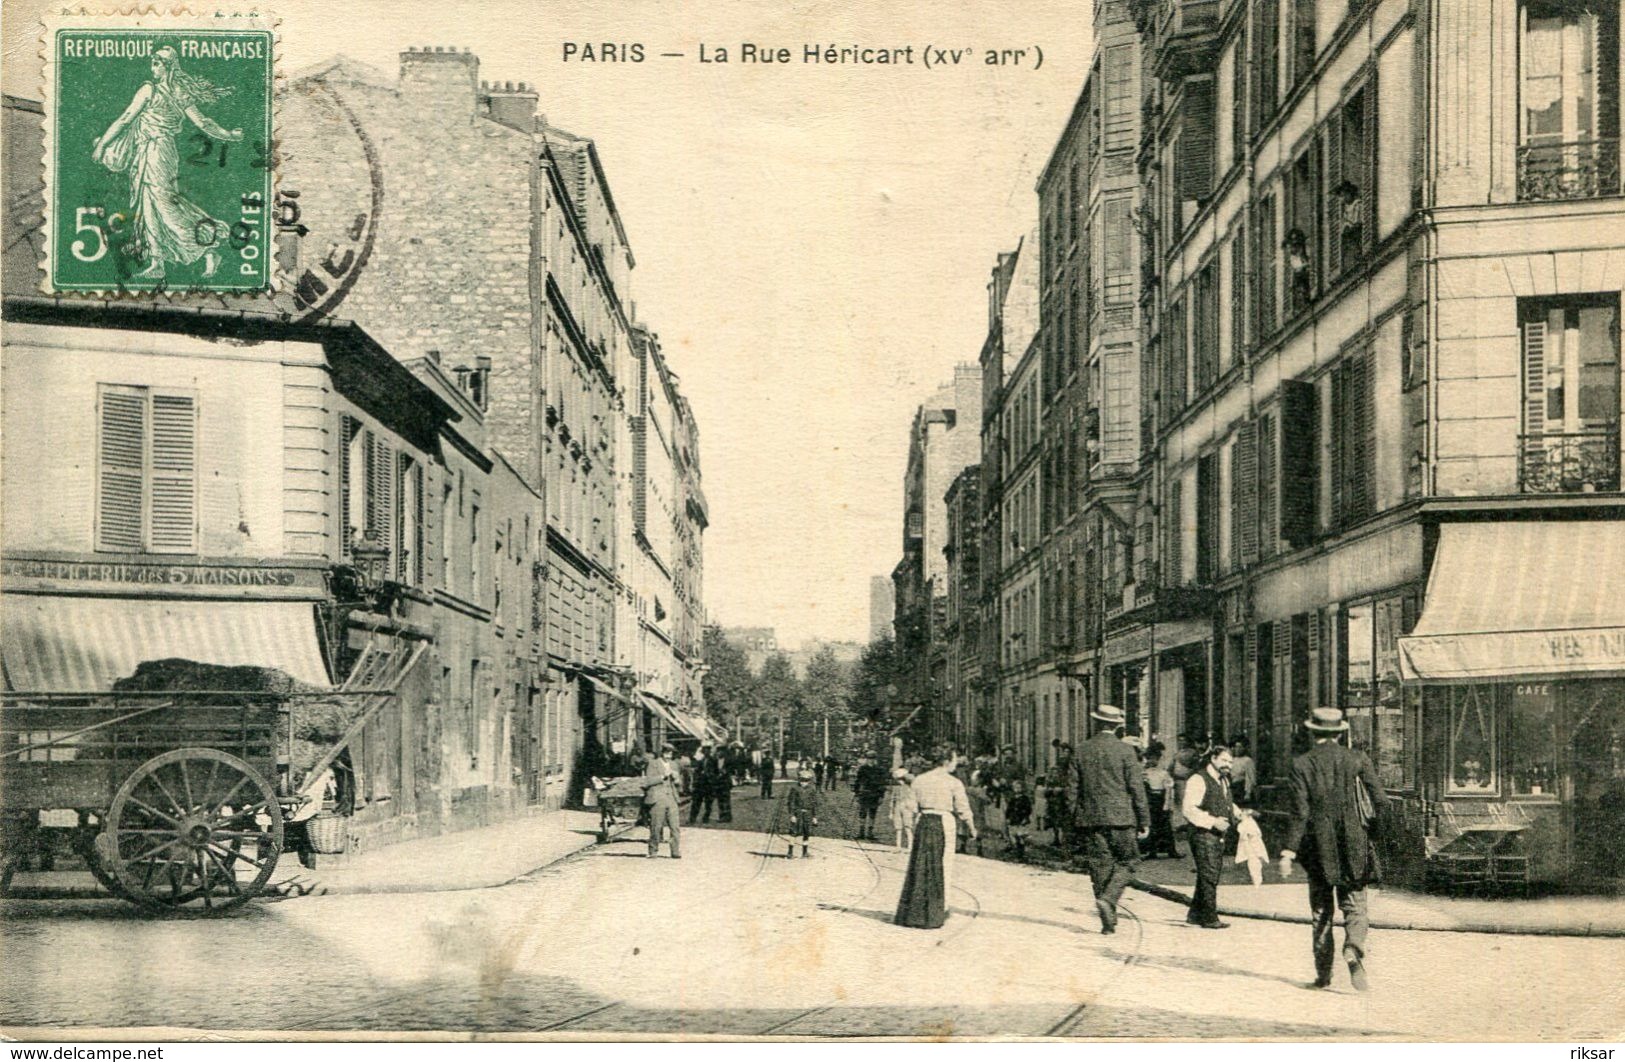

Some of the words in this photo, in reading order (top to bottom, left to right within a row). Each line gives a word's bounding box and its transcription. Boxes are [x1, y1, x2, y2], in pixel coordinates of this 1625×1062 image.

[181, 40, 264, 61] FRANÇAISE
[240, 190, 263, 276] POSTES
[138, 568, 163, 582] des
[169, 567, 187, 584] 5
[191, 567, 279, 585] MAISONS
